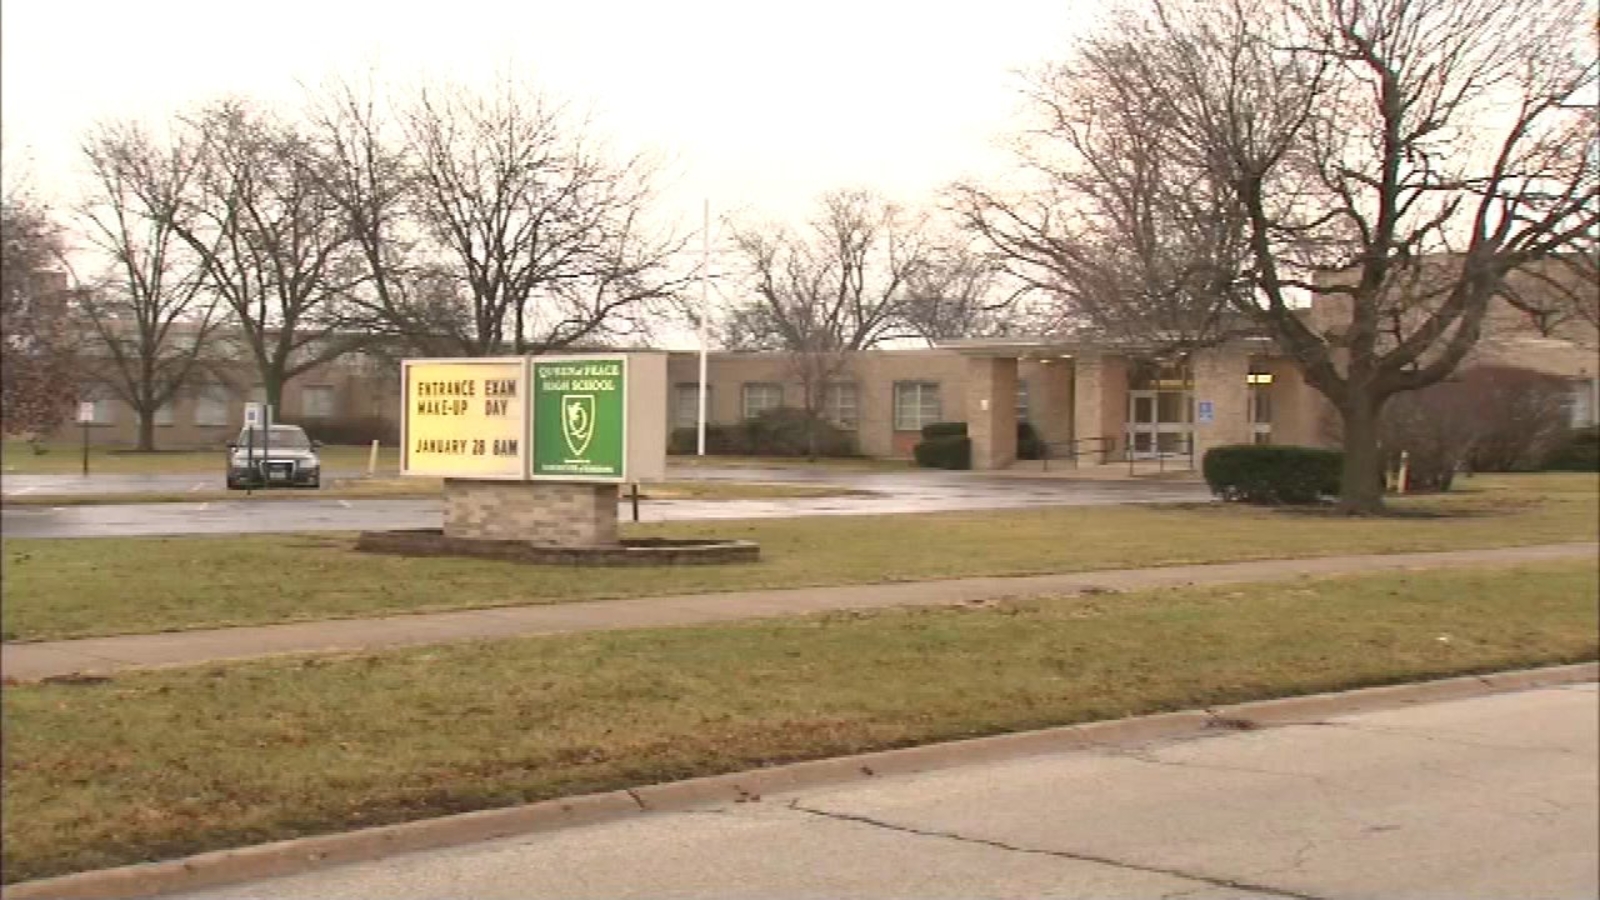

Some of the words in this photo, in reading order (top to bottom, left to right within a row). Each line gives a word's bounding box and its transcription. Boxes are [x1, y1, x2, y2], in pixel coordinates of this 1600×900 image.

[418, 380, 475, 397] ENTRANCE
[485, 379, 517, 397] EXAM
[543, 380, 570, 391] HIGH
[571, 379, 616, 391] SCHOOL
[418, 399, 468, 416] MAKE-UP
[485, 399, 508, 416] DAY
[415, 438, 467, 454] JANUARY
[473, 438, 486, 456] 28
